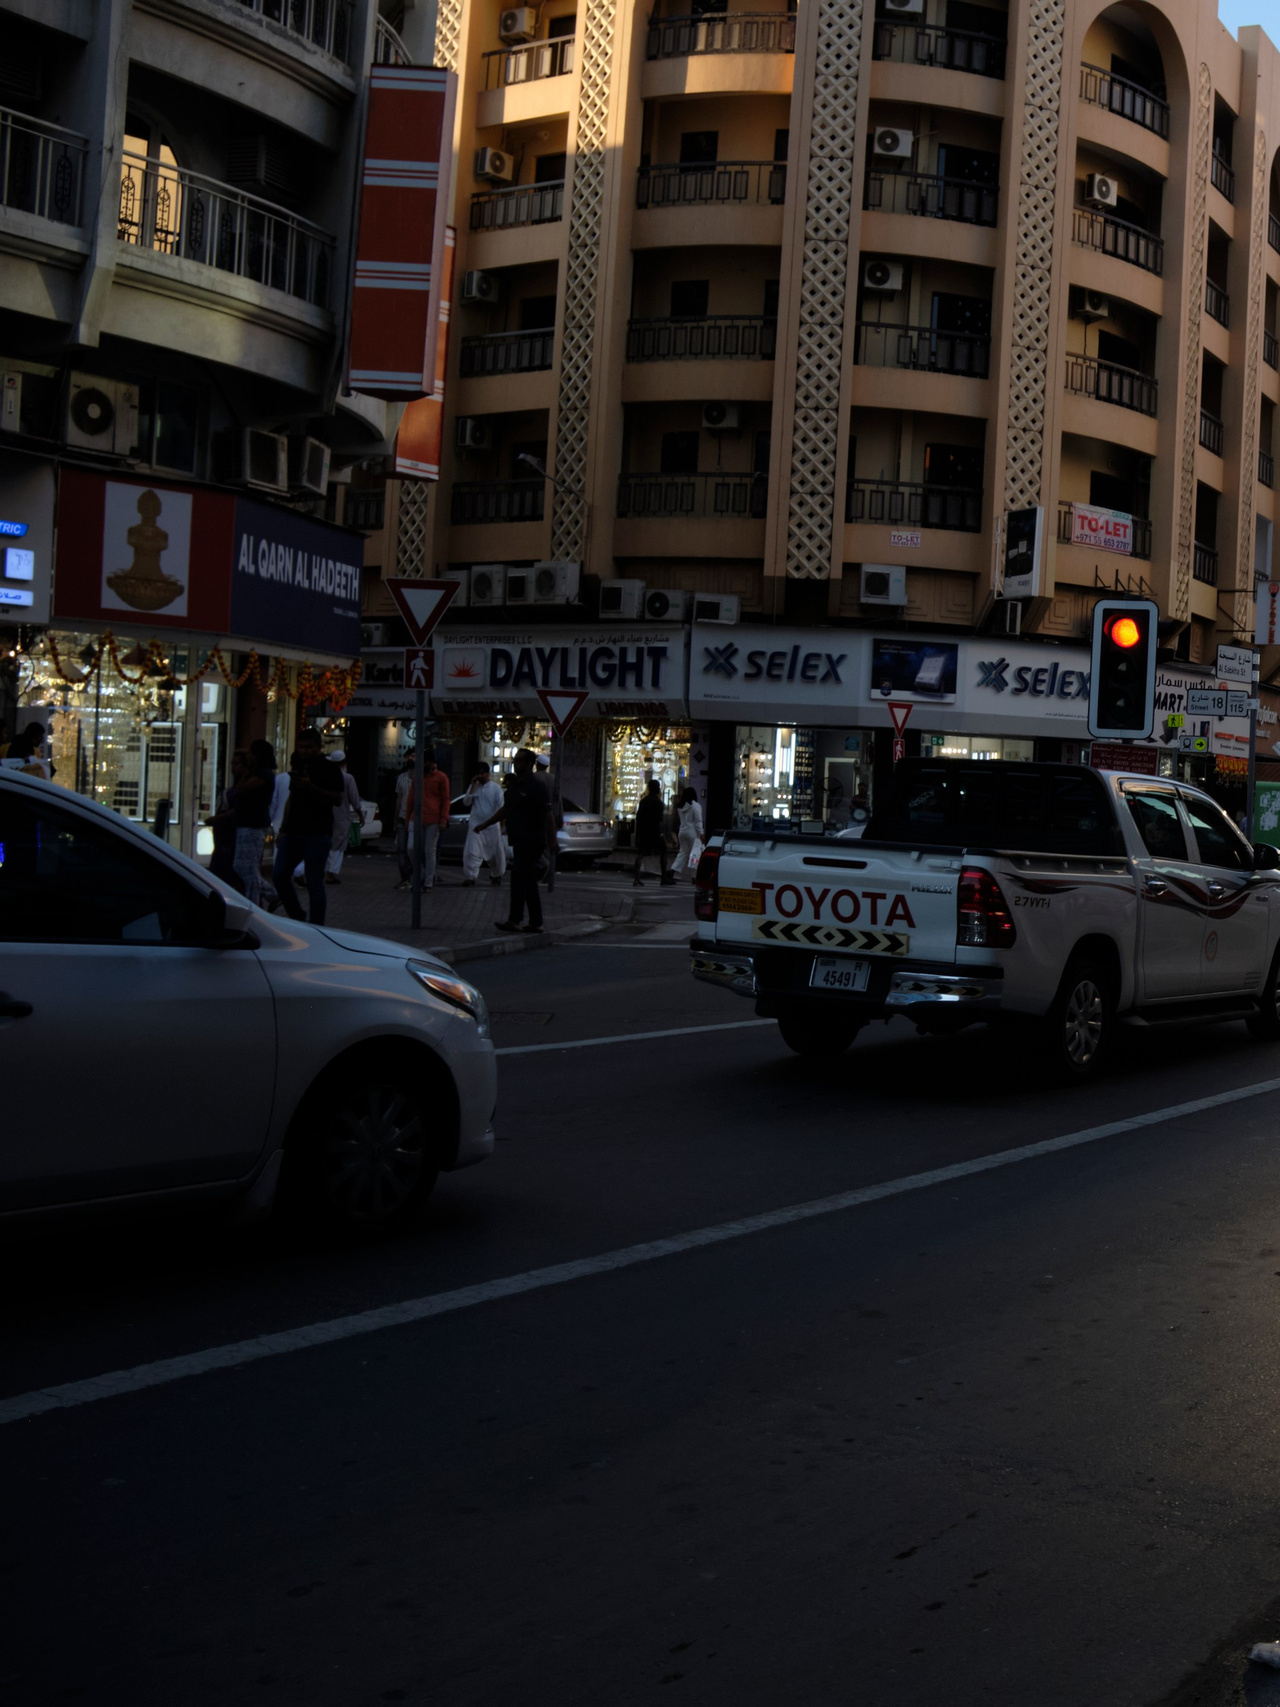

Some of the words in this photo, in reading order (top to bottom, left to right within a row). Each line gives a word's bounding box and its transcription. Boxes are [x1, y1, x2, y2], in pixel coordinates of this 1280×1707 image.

[1077, 514, 1129, 539] TO-LET
[892, 534, 919, 542] TO-LET
[1075, 533, 1091, 543] +971
[1093, 536, 1102, 545] 55
[1103, 538, 1115, 547] 653
[238, 533, 255, 575] AL
[258, 538, 294, 585] QARN
[294, 549, 309, 589] AL
[311, 554, 360, 602] HADEETH
[490, 647, 667, 687] DAYLIGHT
[1191, 694, 1209, 703] شارع
[1212, 697, 1223, 709] 18
[597, 702, 668, 715] LIGHTINGS
[1230, 704, 1244, 713] 115
[752, 882, 916, 929] TOYOTA
[823, 970, 857, 987] 45491
